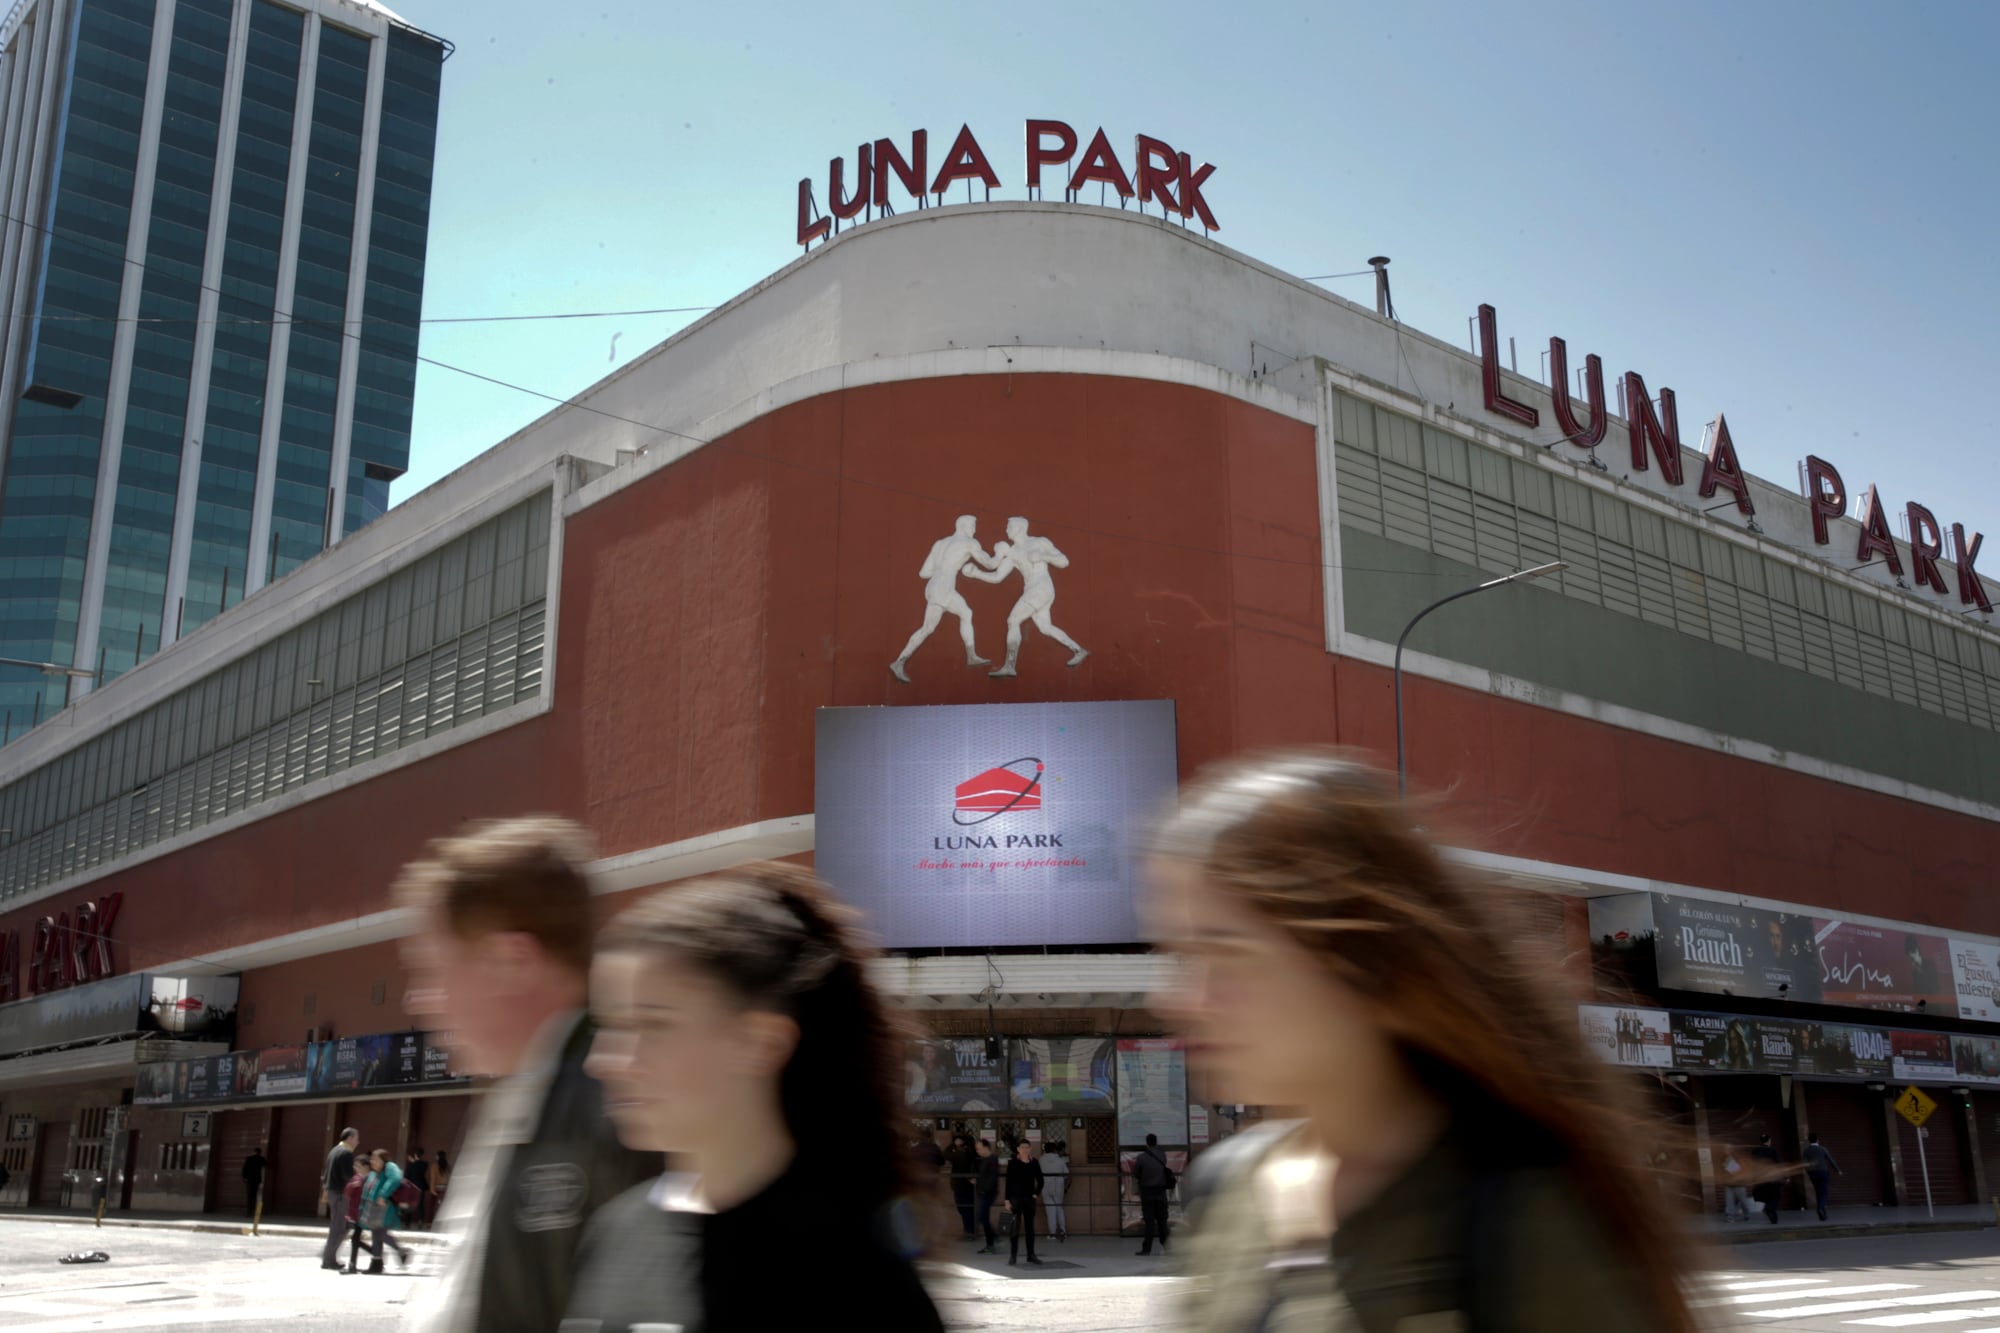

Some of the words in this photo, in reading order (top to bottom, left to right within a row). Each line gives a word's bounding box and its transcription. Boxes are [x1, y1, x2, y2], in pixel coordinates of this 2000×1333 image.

[797, 122, 1001, 245] LUNA
[1025, 119, 1220, 231] PARK
[1478, 303, 1756, 516] LUNA
[1806, 454, 1994, 613] PARK
[934, 836, 998, 850] LUNA
[1006, 834, 1064, 849] PARK
[989, 860, 1009, 873] que
[28, 892, 124, 994] PARK
[1681, 926, 1744, 967] Rauch
[1694, 1016, 1727, 1030] KARINA
[1762, 1034, 1792, 1056] Rauch
[1854, 1031, 1885, 1060] UB40
[21, 1124, 28, 1135] 3
[192, 1120, 200, 1132] 2
[985, 1119, 991, 1128] 2
[1029, 1119, 1037, 1128] 3
[1074, 1118, 1082, 1128] 4
